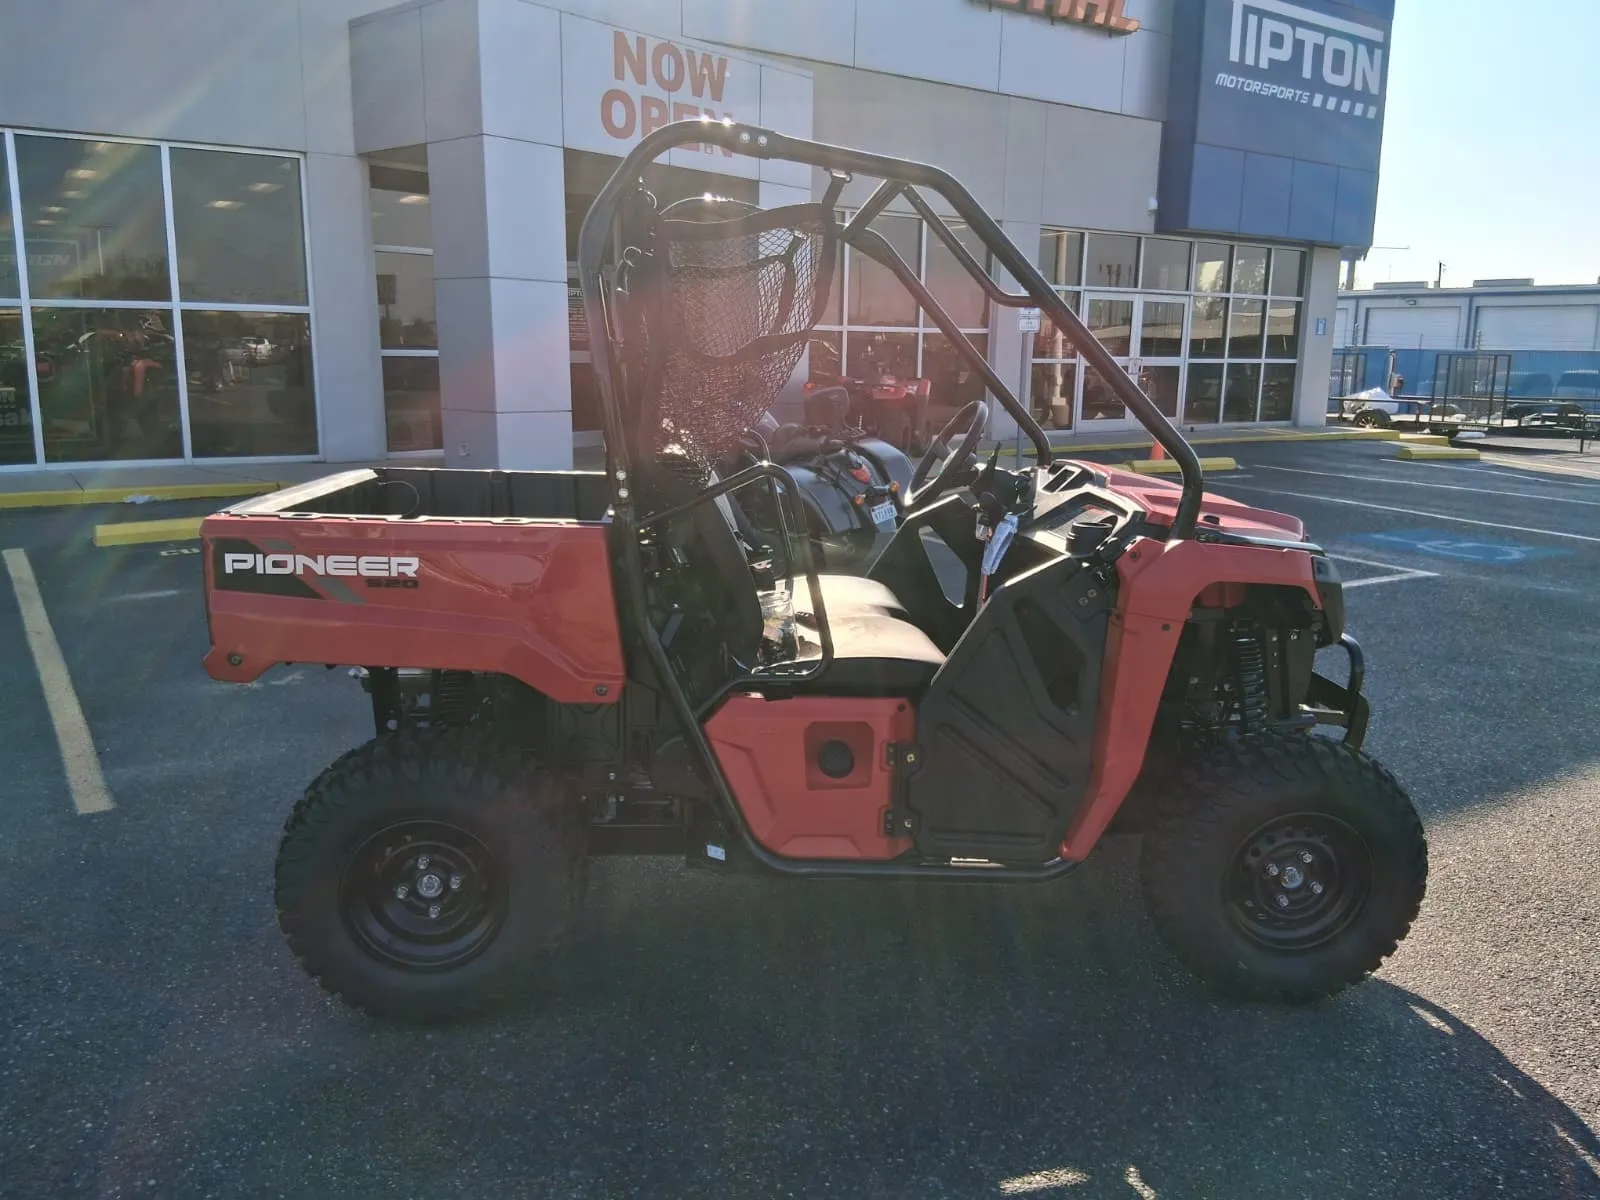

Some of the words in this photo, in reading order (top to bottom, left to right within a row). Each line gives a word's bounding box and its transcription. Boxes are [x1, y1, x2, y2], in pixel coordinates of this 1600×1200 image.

[613, 31, 728, 102] NOW
[1229, 0, 1384, 95] TIPTON
[1215, 73, 1311, 104] MOTORSPORTS
[224, 552, 419, 577] PIONEER
